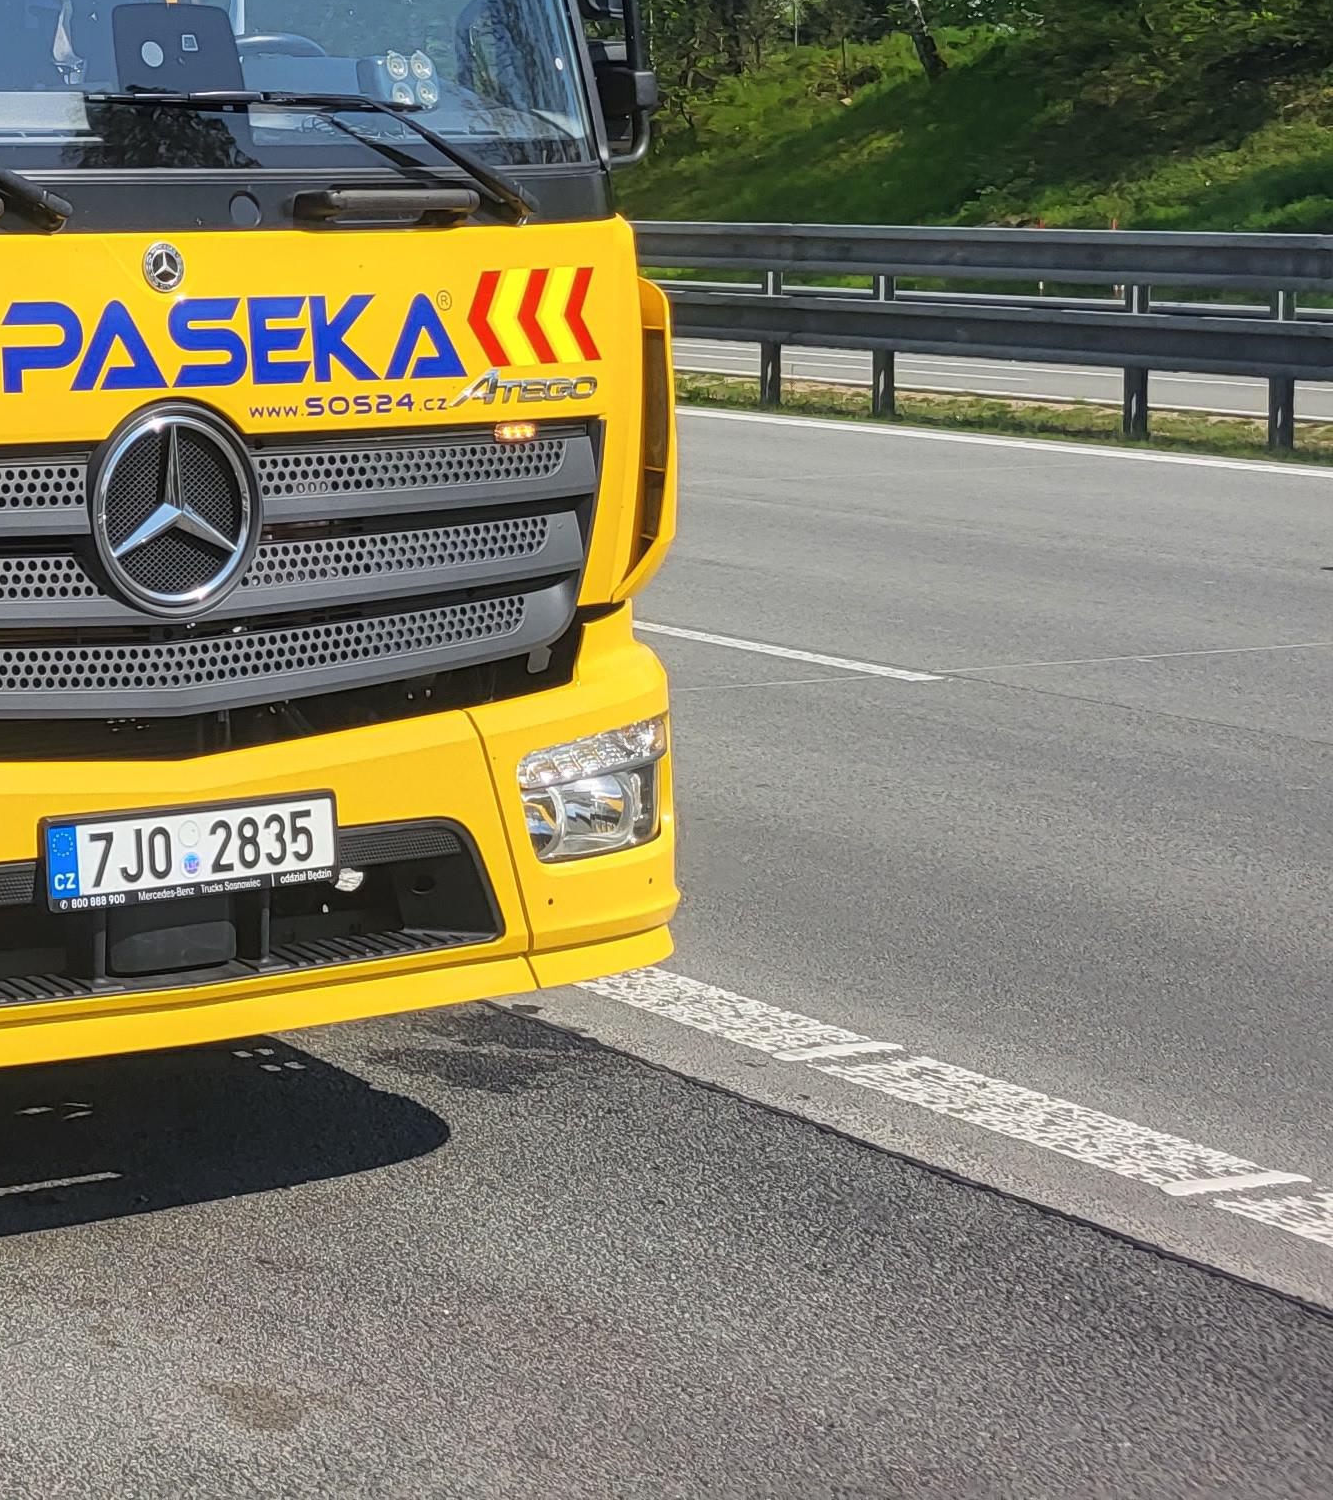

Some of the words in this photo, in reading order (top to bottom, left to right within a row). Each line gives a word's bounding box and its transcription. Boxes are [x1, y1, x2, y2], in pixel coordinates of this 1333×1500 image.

[248, 392, 448, 419] www.SOS24.cz
[208, 808, 314, 875] 2835
[54, 873, 76, 890] CZ
[108, 893, 126, 905] 900
[137, 885, 195, 901] Mercedes-Benz
[200, 883, 224, 894] Trucks
